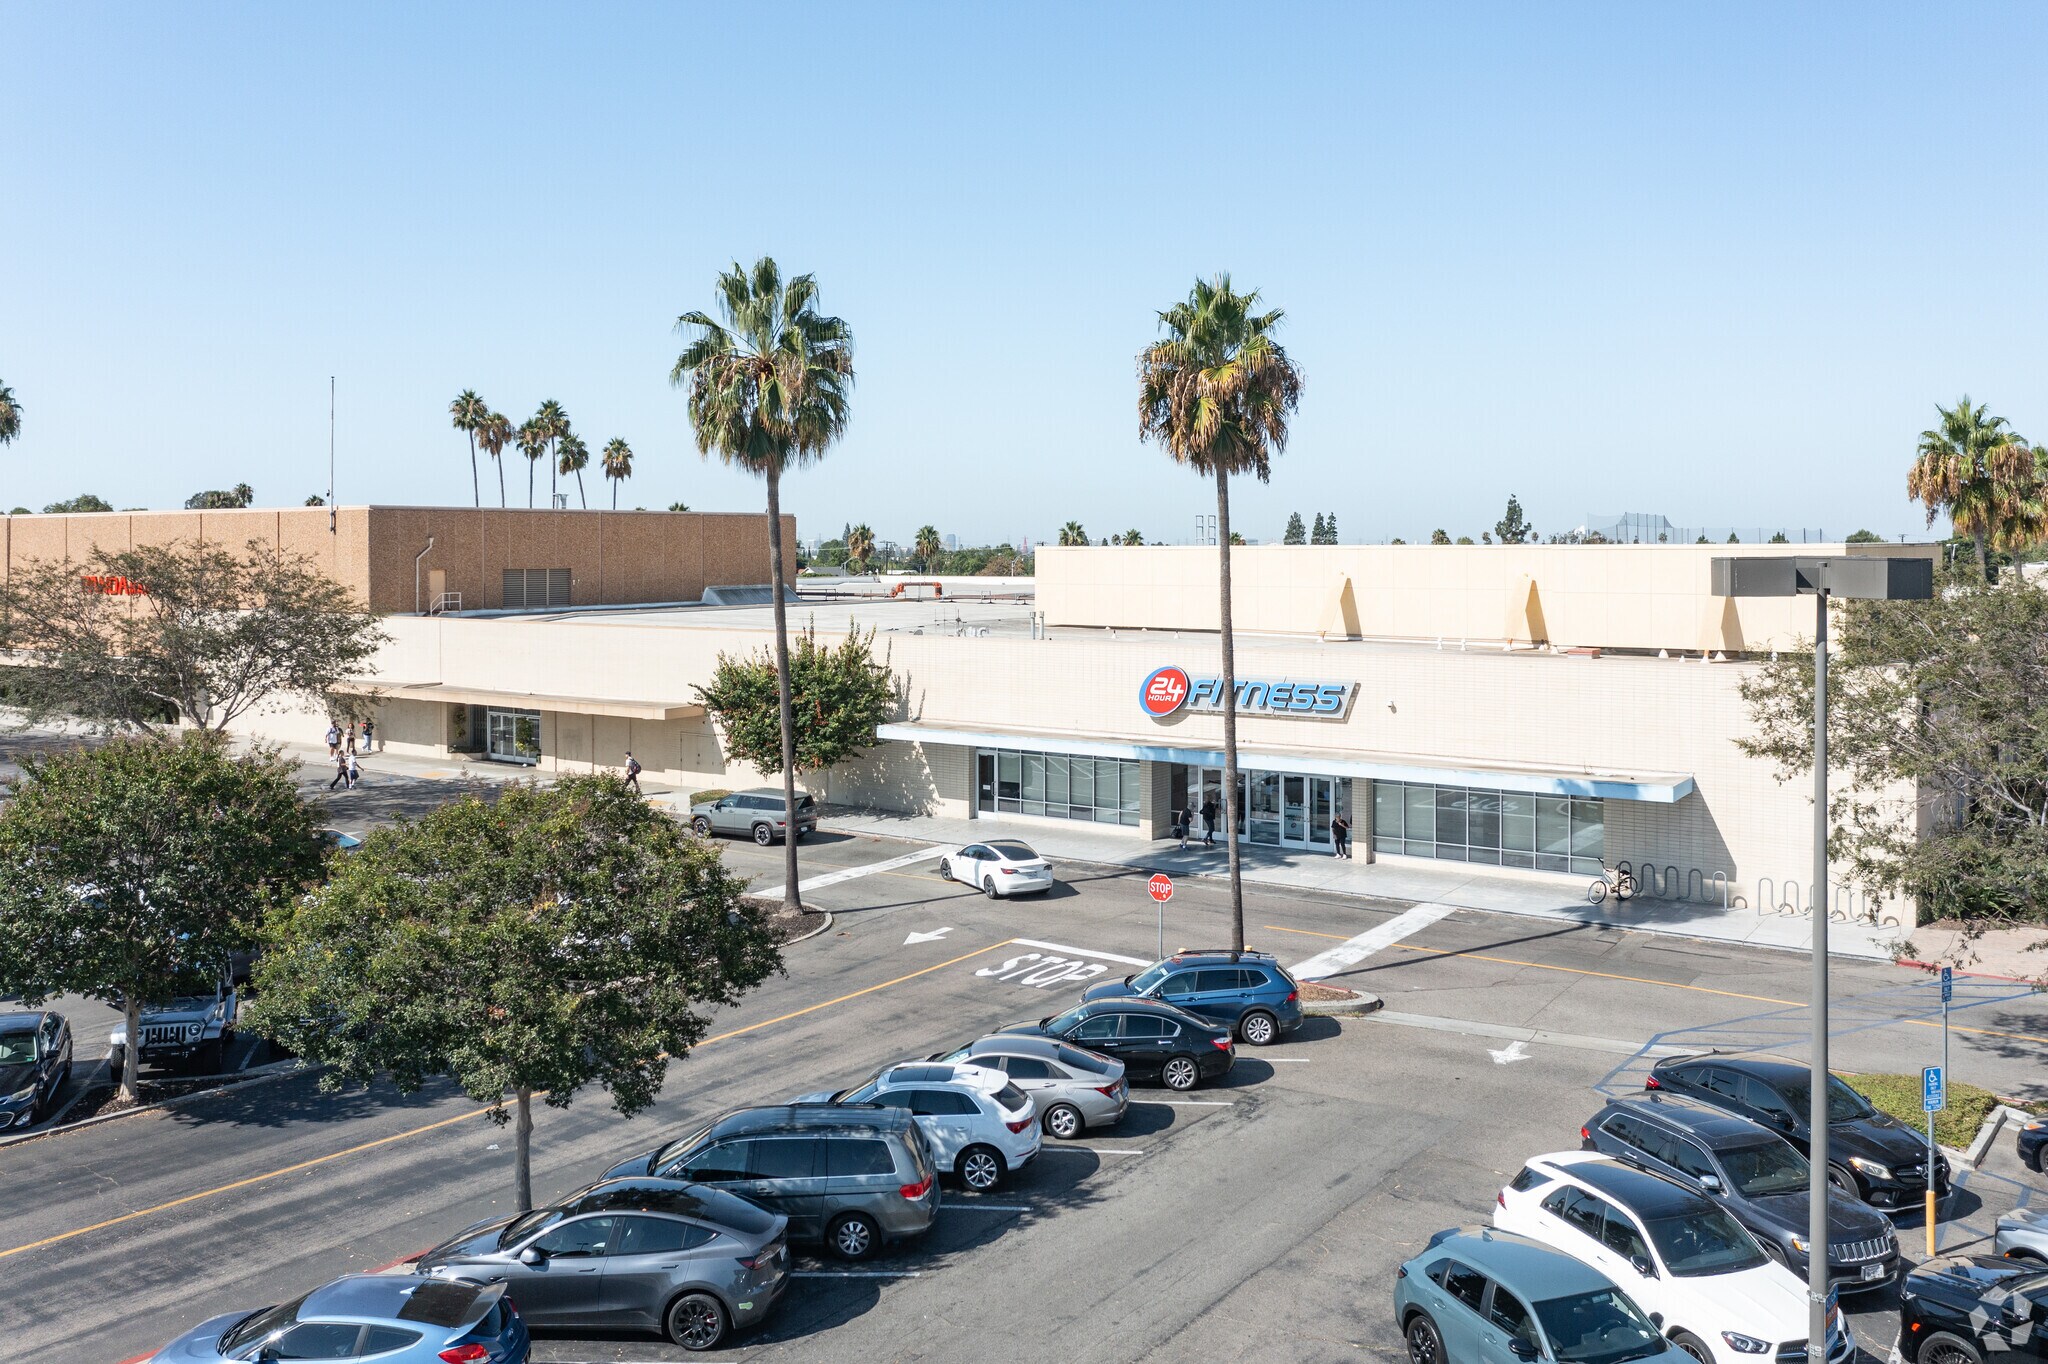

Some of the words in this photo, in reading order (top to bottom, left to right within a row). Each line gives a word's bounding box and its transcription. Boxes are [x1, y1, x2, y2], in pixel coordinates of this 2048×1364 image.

[1147, 694, 1172, 702] HOUR
[1150, 676, 1184, 702] 24
[1150, 881, 1171, 894] STOP
[975, 953, 1109, 988] STOP
